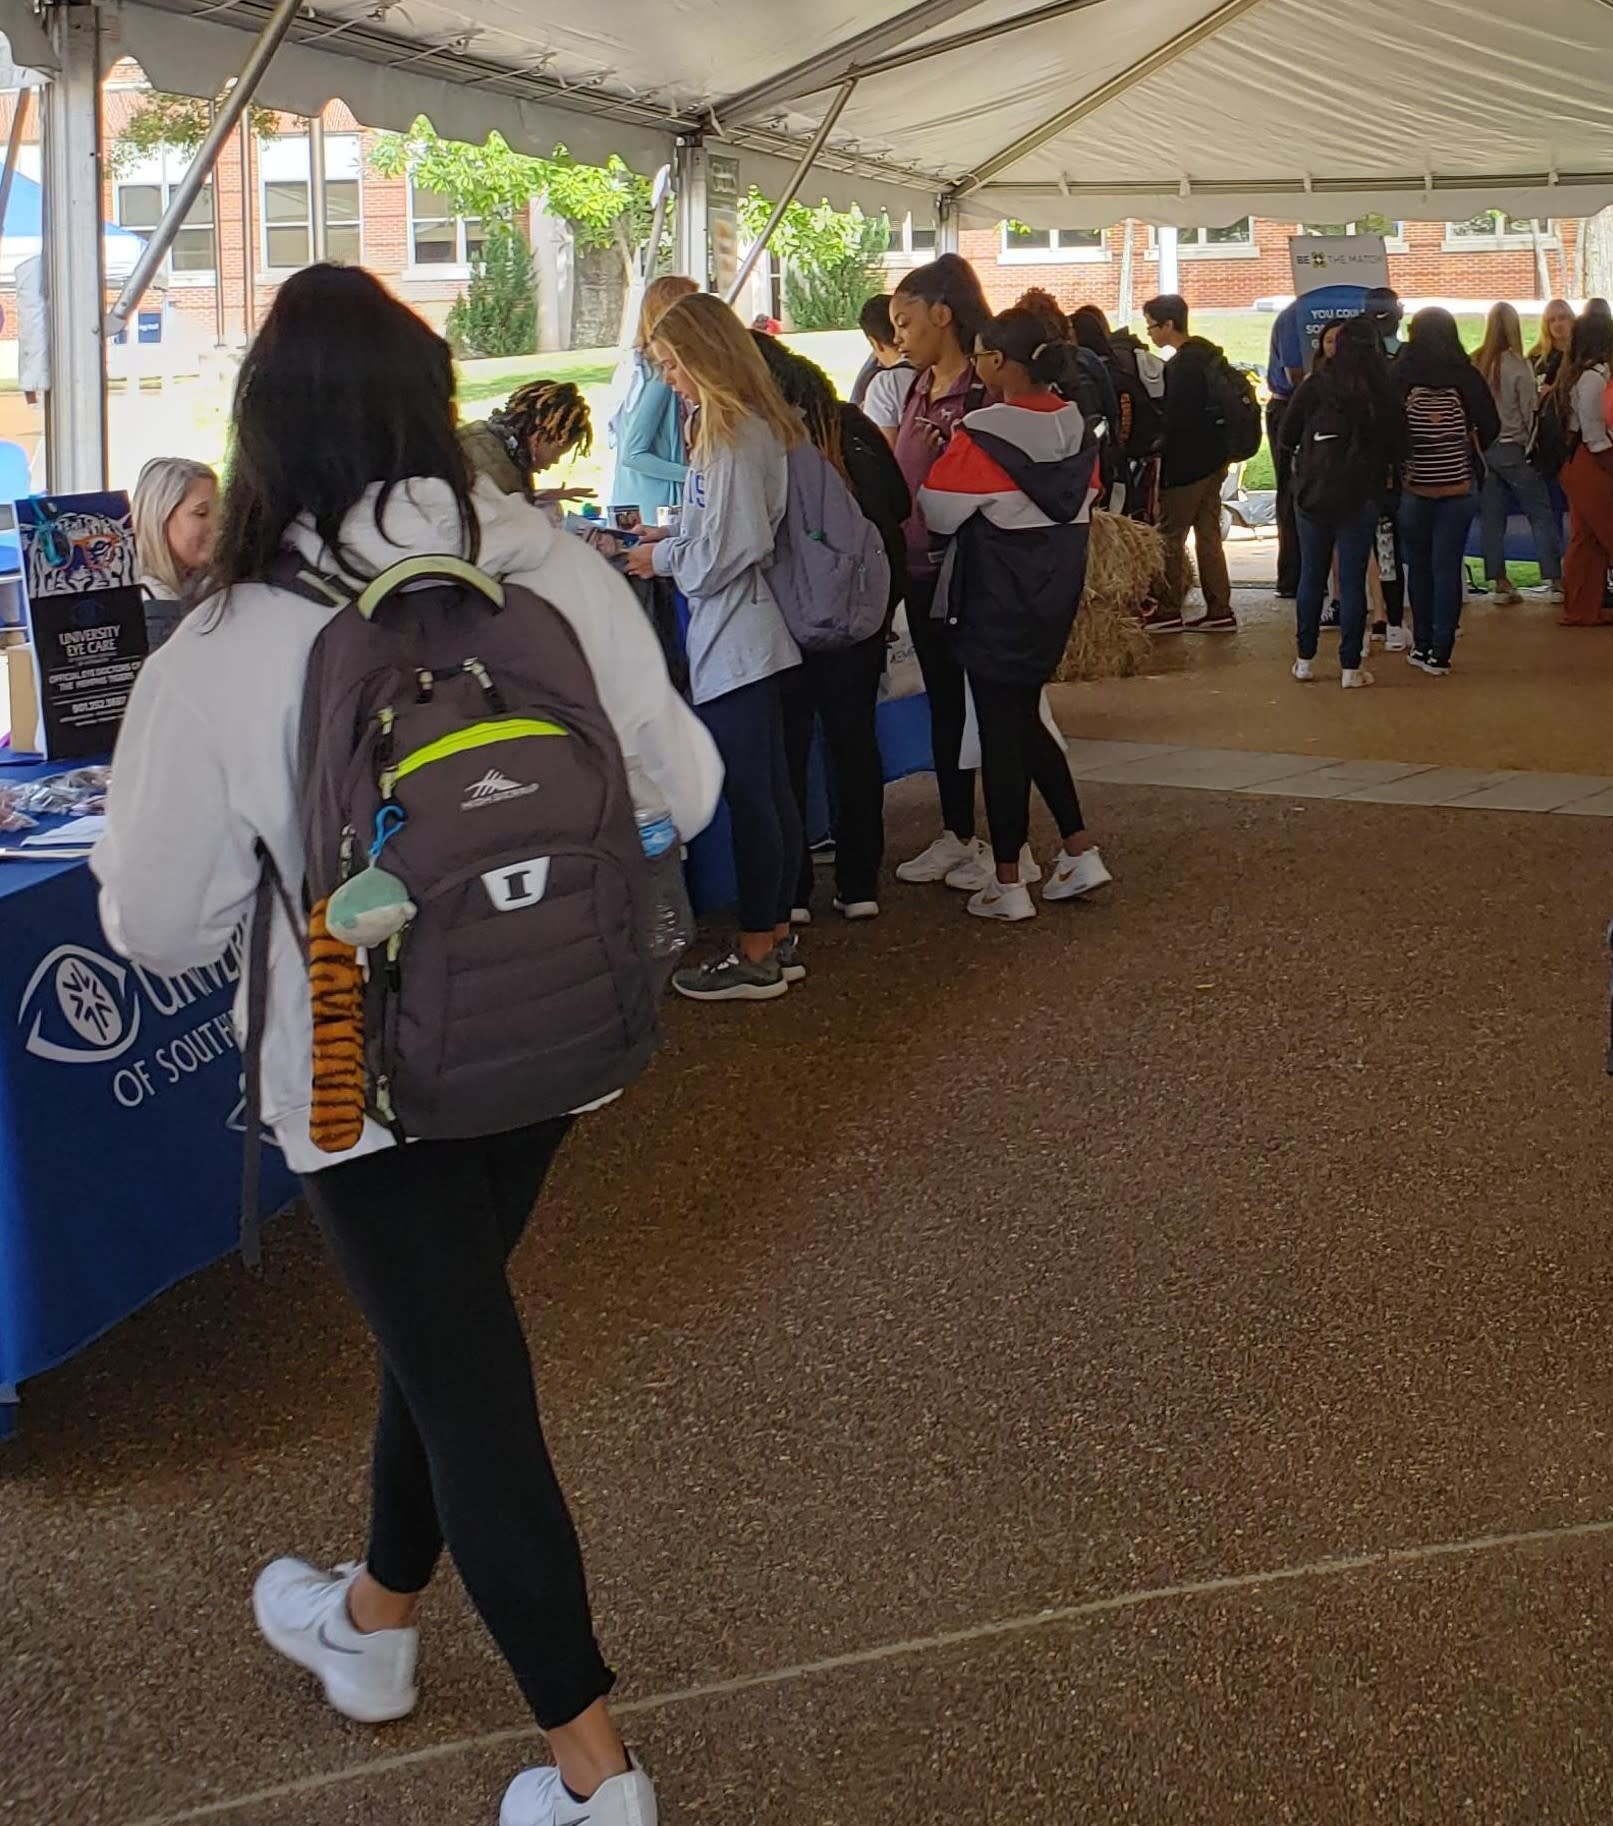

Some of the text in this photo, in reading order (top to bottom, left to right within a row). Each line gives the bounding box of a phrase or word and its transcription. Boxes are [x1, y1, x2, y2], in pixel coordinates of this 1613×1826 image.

[1296, 255, 1310, 265] BE
[1311, 309, 1334, 320] YOU
[59, 626, 120, 645] UNIVERSITY
[66, 639, 118, 657] EYE CARE
[113, 1009, 239, 1107] OF SOUTH
